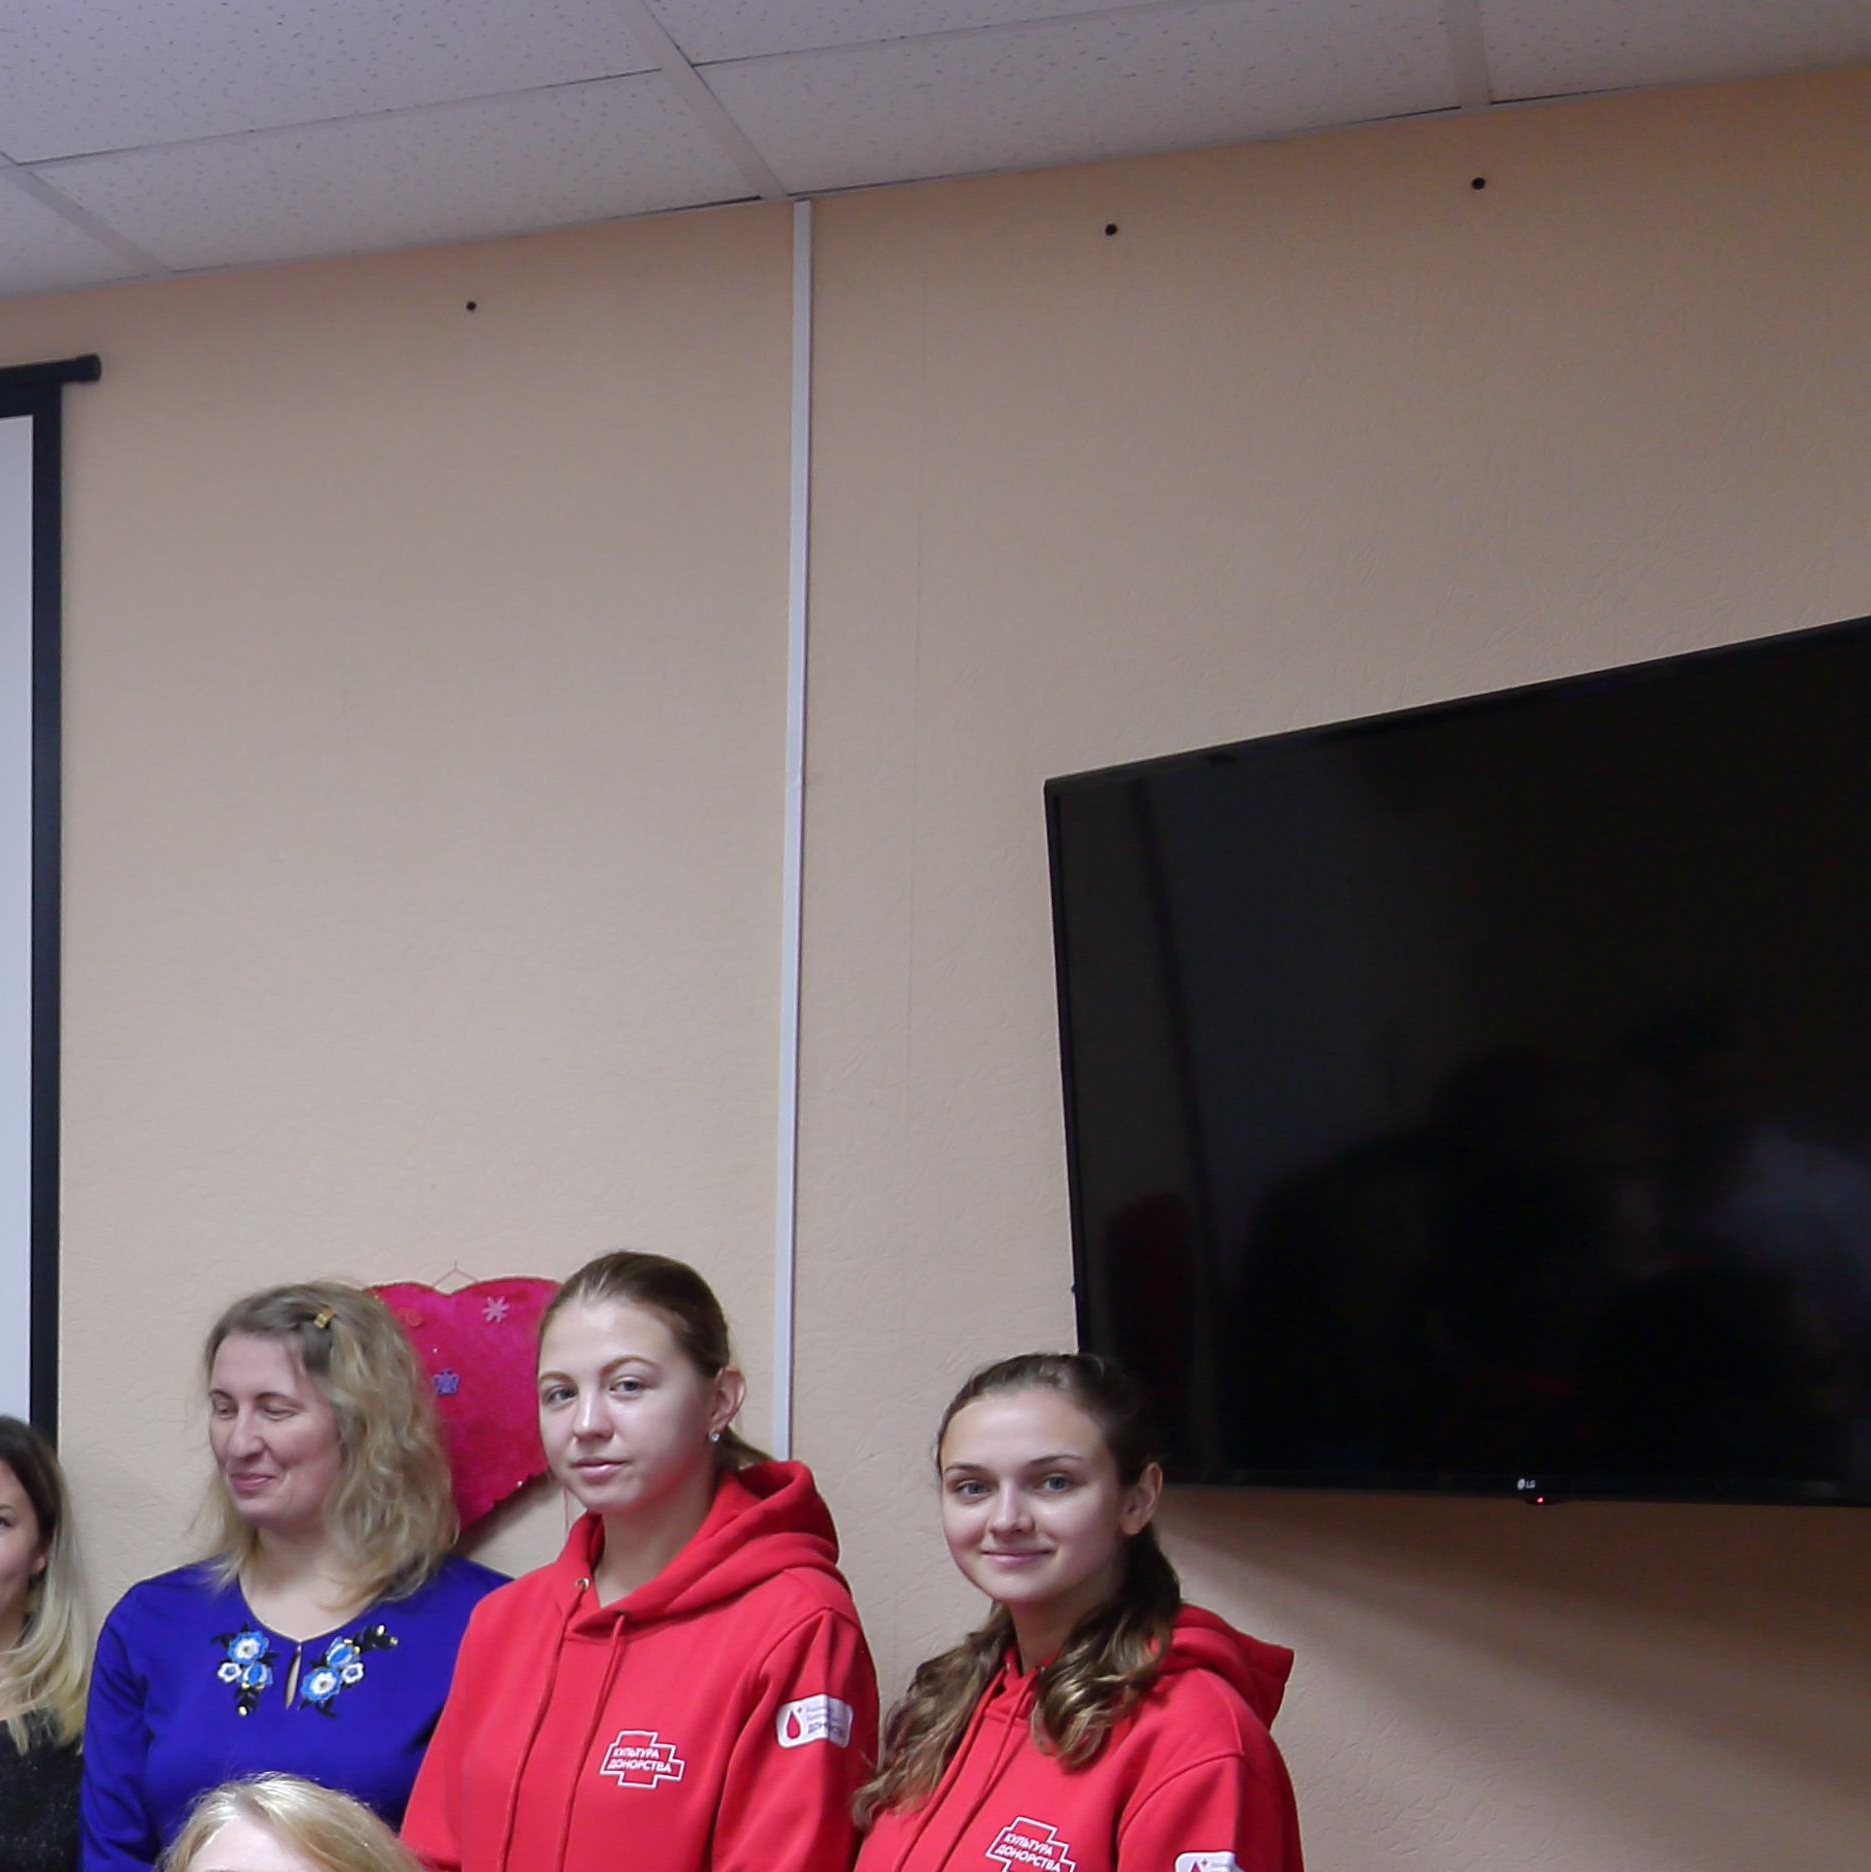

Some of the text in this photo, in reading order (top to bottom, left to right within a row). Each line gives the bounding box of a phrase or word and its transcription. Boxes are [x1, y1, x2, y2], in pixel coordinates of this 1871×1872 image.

[612, 1747, 660, 1758] КУЛЬТУРА
[607, 1758, 672, 1773] ДОНОРСТВА
[1003, 1833, 1054, 1856] КУЛЬТУРА
[994, 1844, 1061, 1872] ДОНОРСТВА
